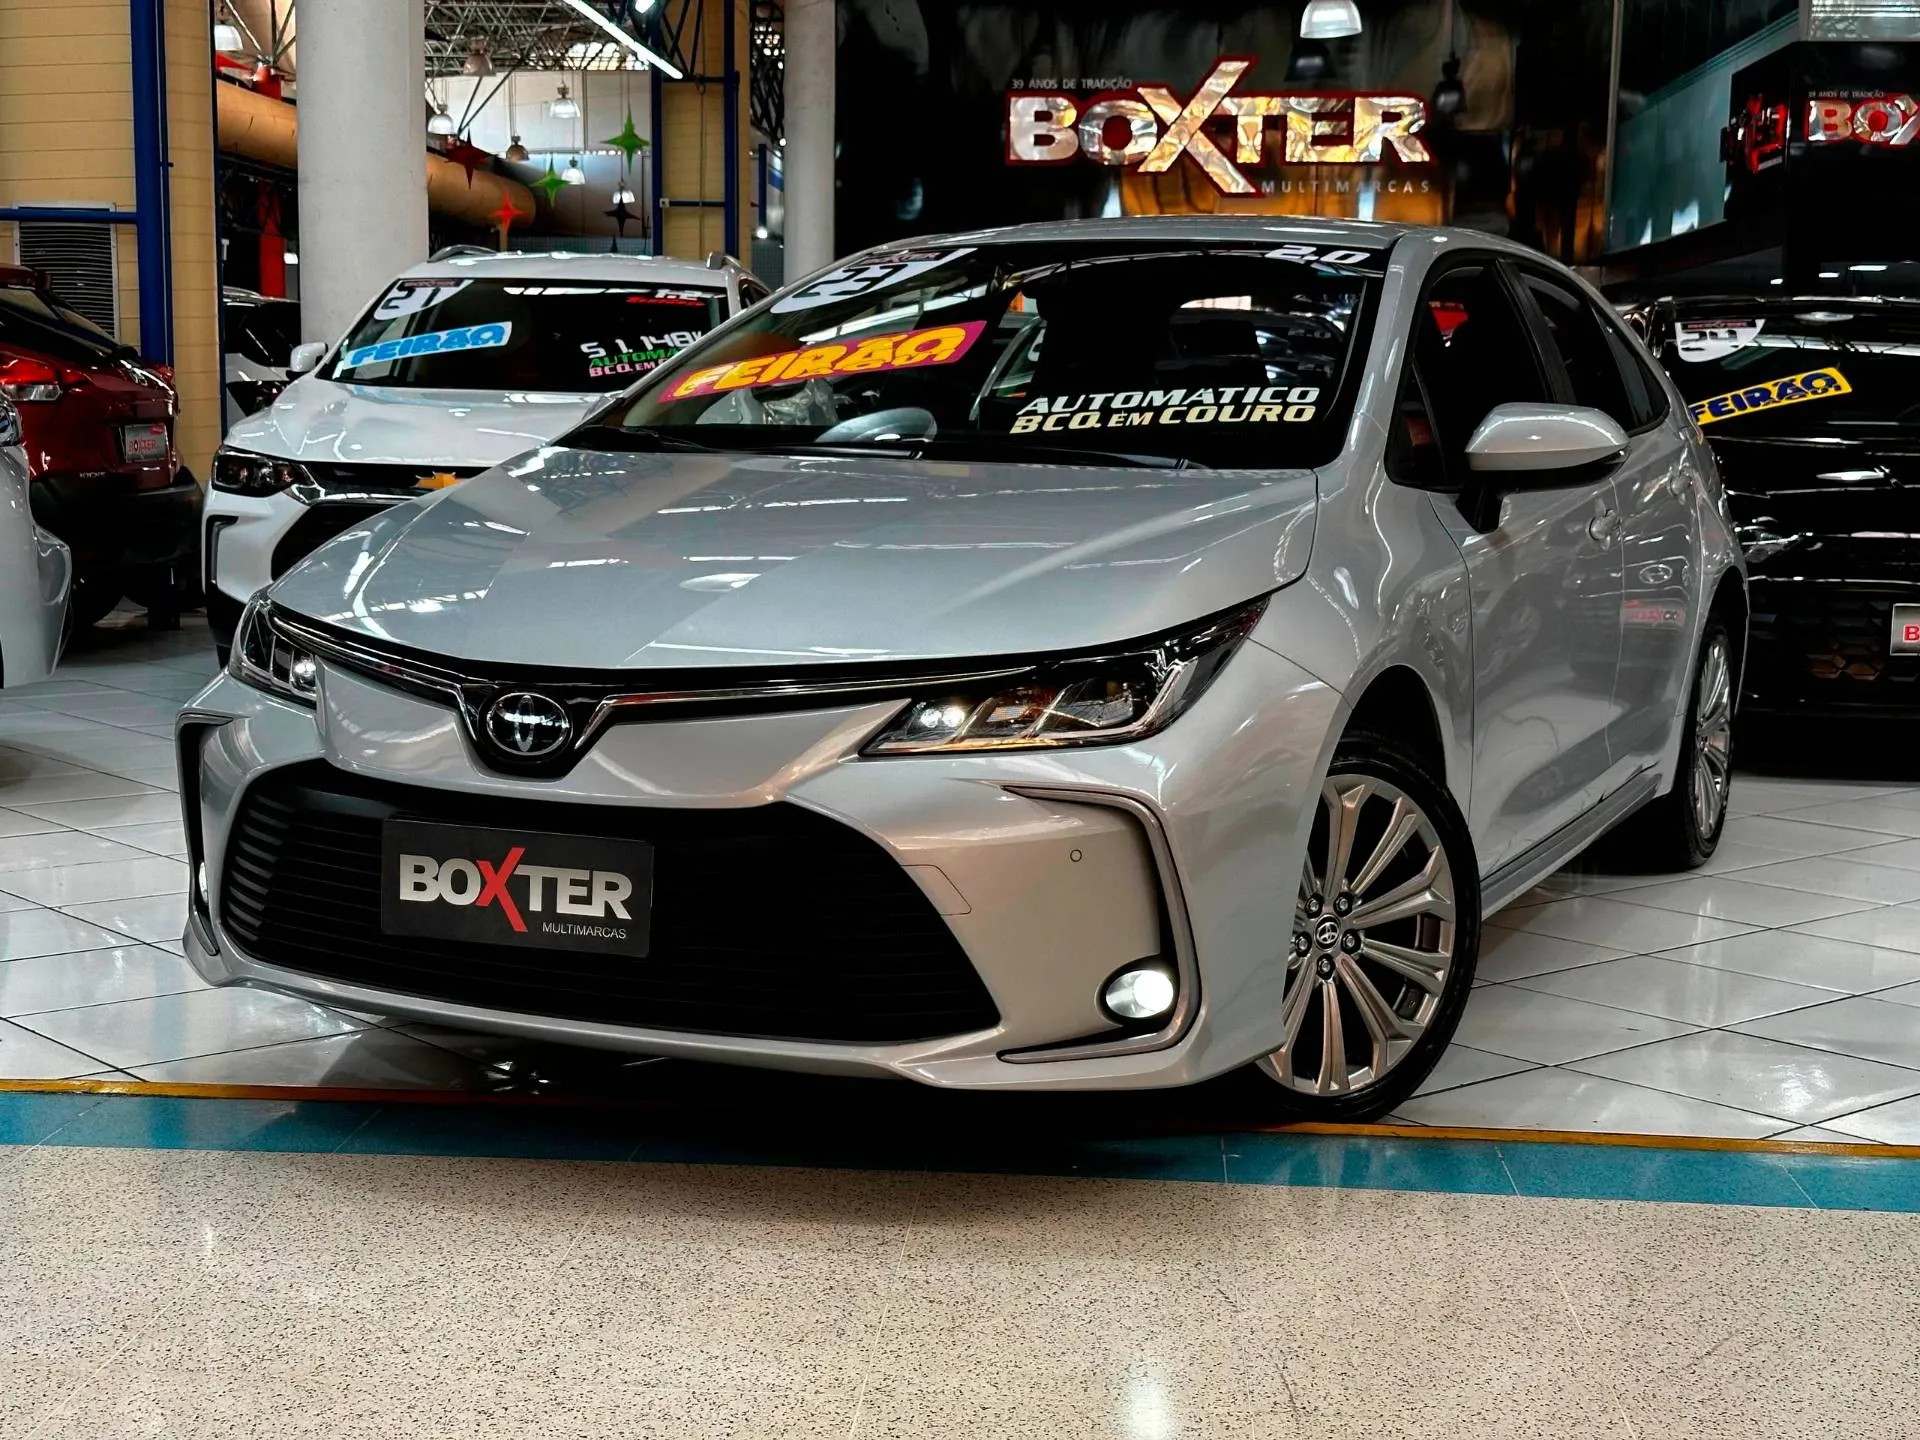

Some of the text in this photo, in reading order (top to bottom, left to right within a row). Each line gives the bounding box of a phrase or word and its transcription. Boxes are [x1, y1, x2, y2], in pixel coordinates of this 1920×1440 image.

[1011, 77, 1132, 92] 39 ANOS DE TRADIÇÃO
[1009, 59, 1432, 194] BOXTER
[1261, 180, 1430, 193] MULTIMARCAS
[1264, 244, 1371, 264] 2.0
[791, 263, 908, 299] 23
[351, 324, 506, 366] FEIRÃO
[673, 327, 967, 397] FEIRÃO
[1016, 387, 1320, 415] AUTOMATICO
[1689, 372, 1839, 421] FEIRÃO
[1107, 411, 1154, 428] EM
[1158, 404, 1316, 424] COURO
[400, 847, 632, 933] BOXTER
[542, 921, 627, 939] MULTIMARCAS
